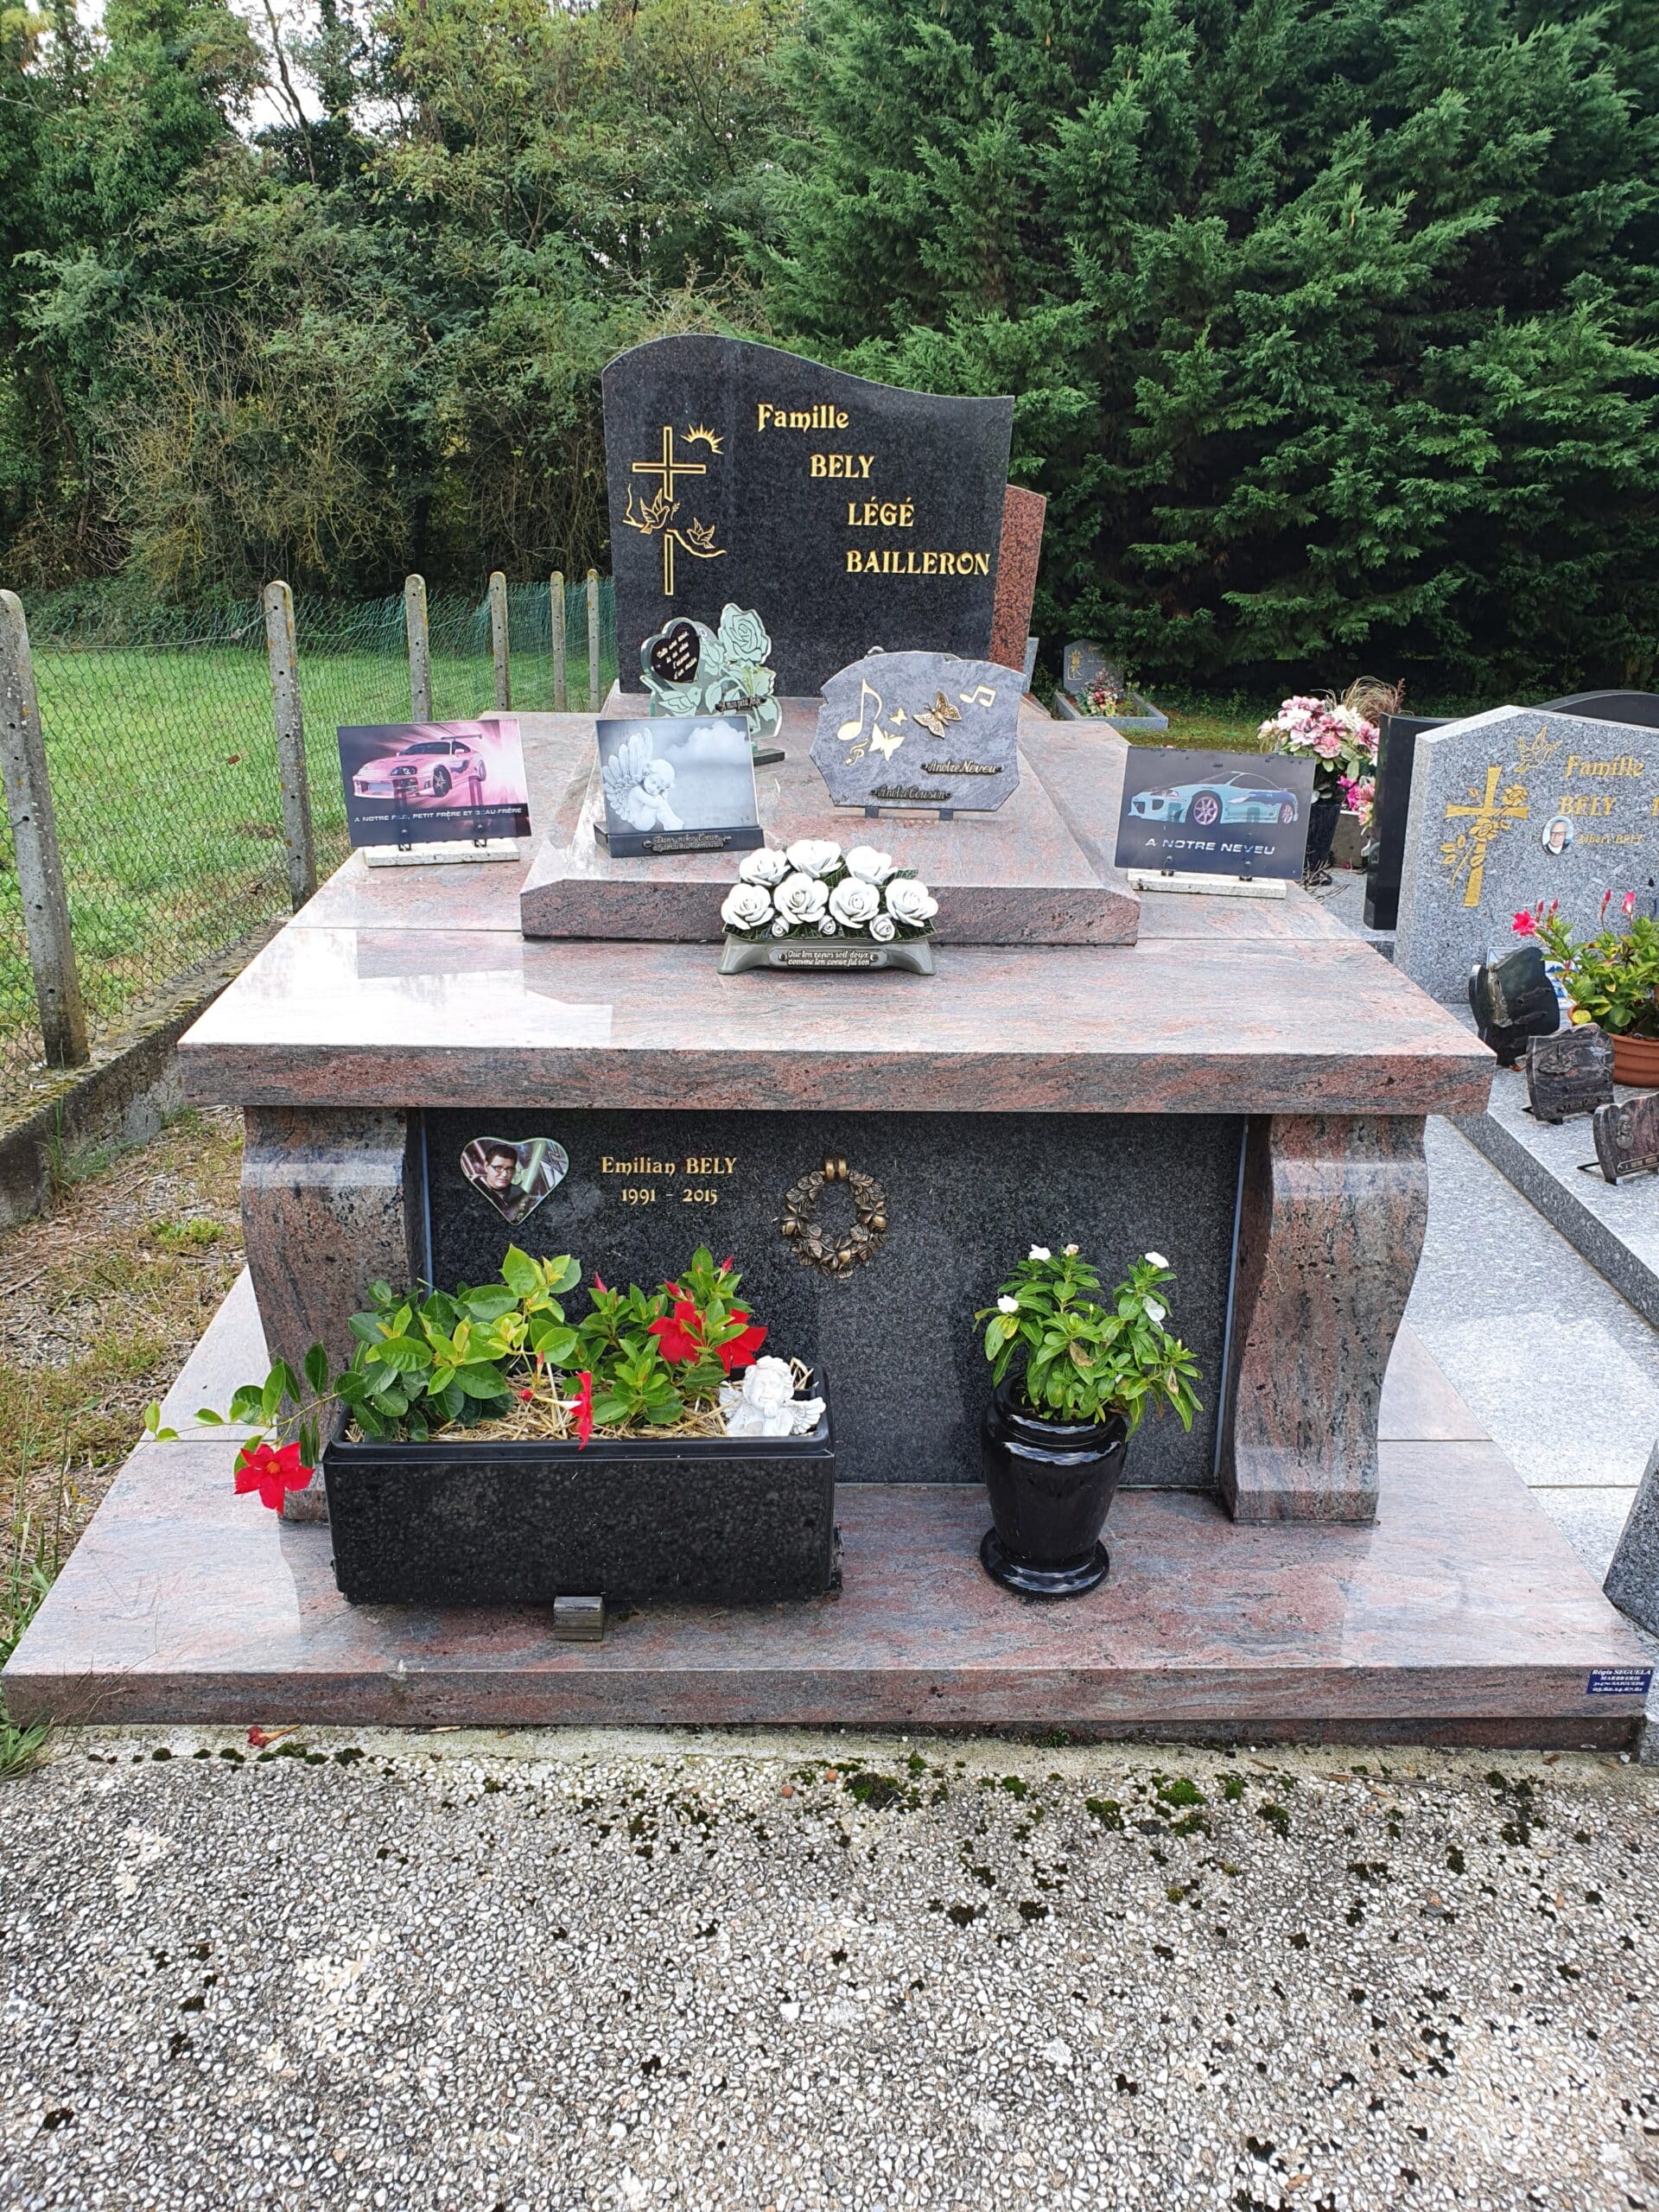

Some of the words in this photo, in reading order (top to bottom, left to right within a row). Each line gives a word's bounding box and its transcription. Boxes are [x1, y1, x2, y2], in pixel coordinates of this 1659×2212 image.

[757, 404, 849, 433] Famille
[810, 454, 875, 479] BELY
[848, 496, 915, 527] LÉGÉ
[846, 550, 991, 576] BAILLERON
[1565, 754, 1644, 779] Famille
[1559, 795, 1616, 817] BELY
[1145, 838, 1156, 847] A
[1162, 839, 1216, 850] NOTRE
[1221, 842, 1275, 855] NEVEU
[601, 1156, 677, 1177] Emilian
[685, 1157, 738, 1174] BELY
[621, 1188, 657, 1205] 1991
[682, 1188, 718, 1206] 2015
